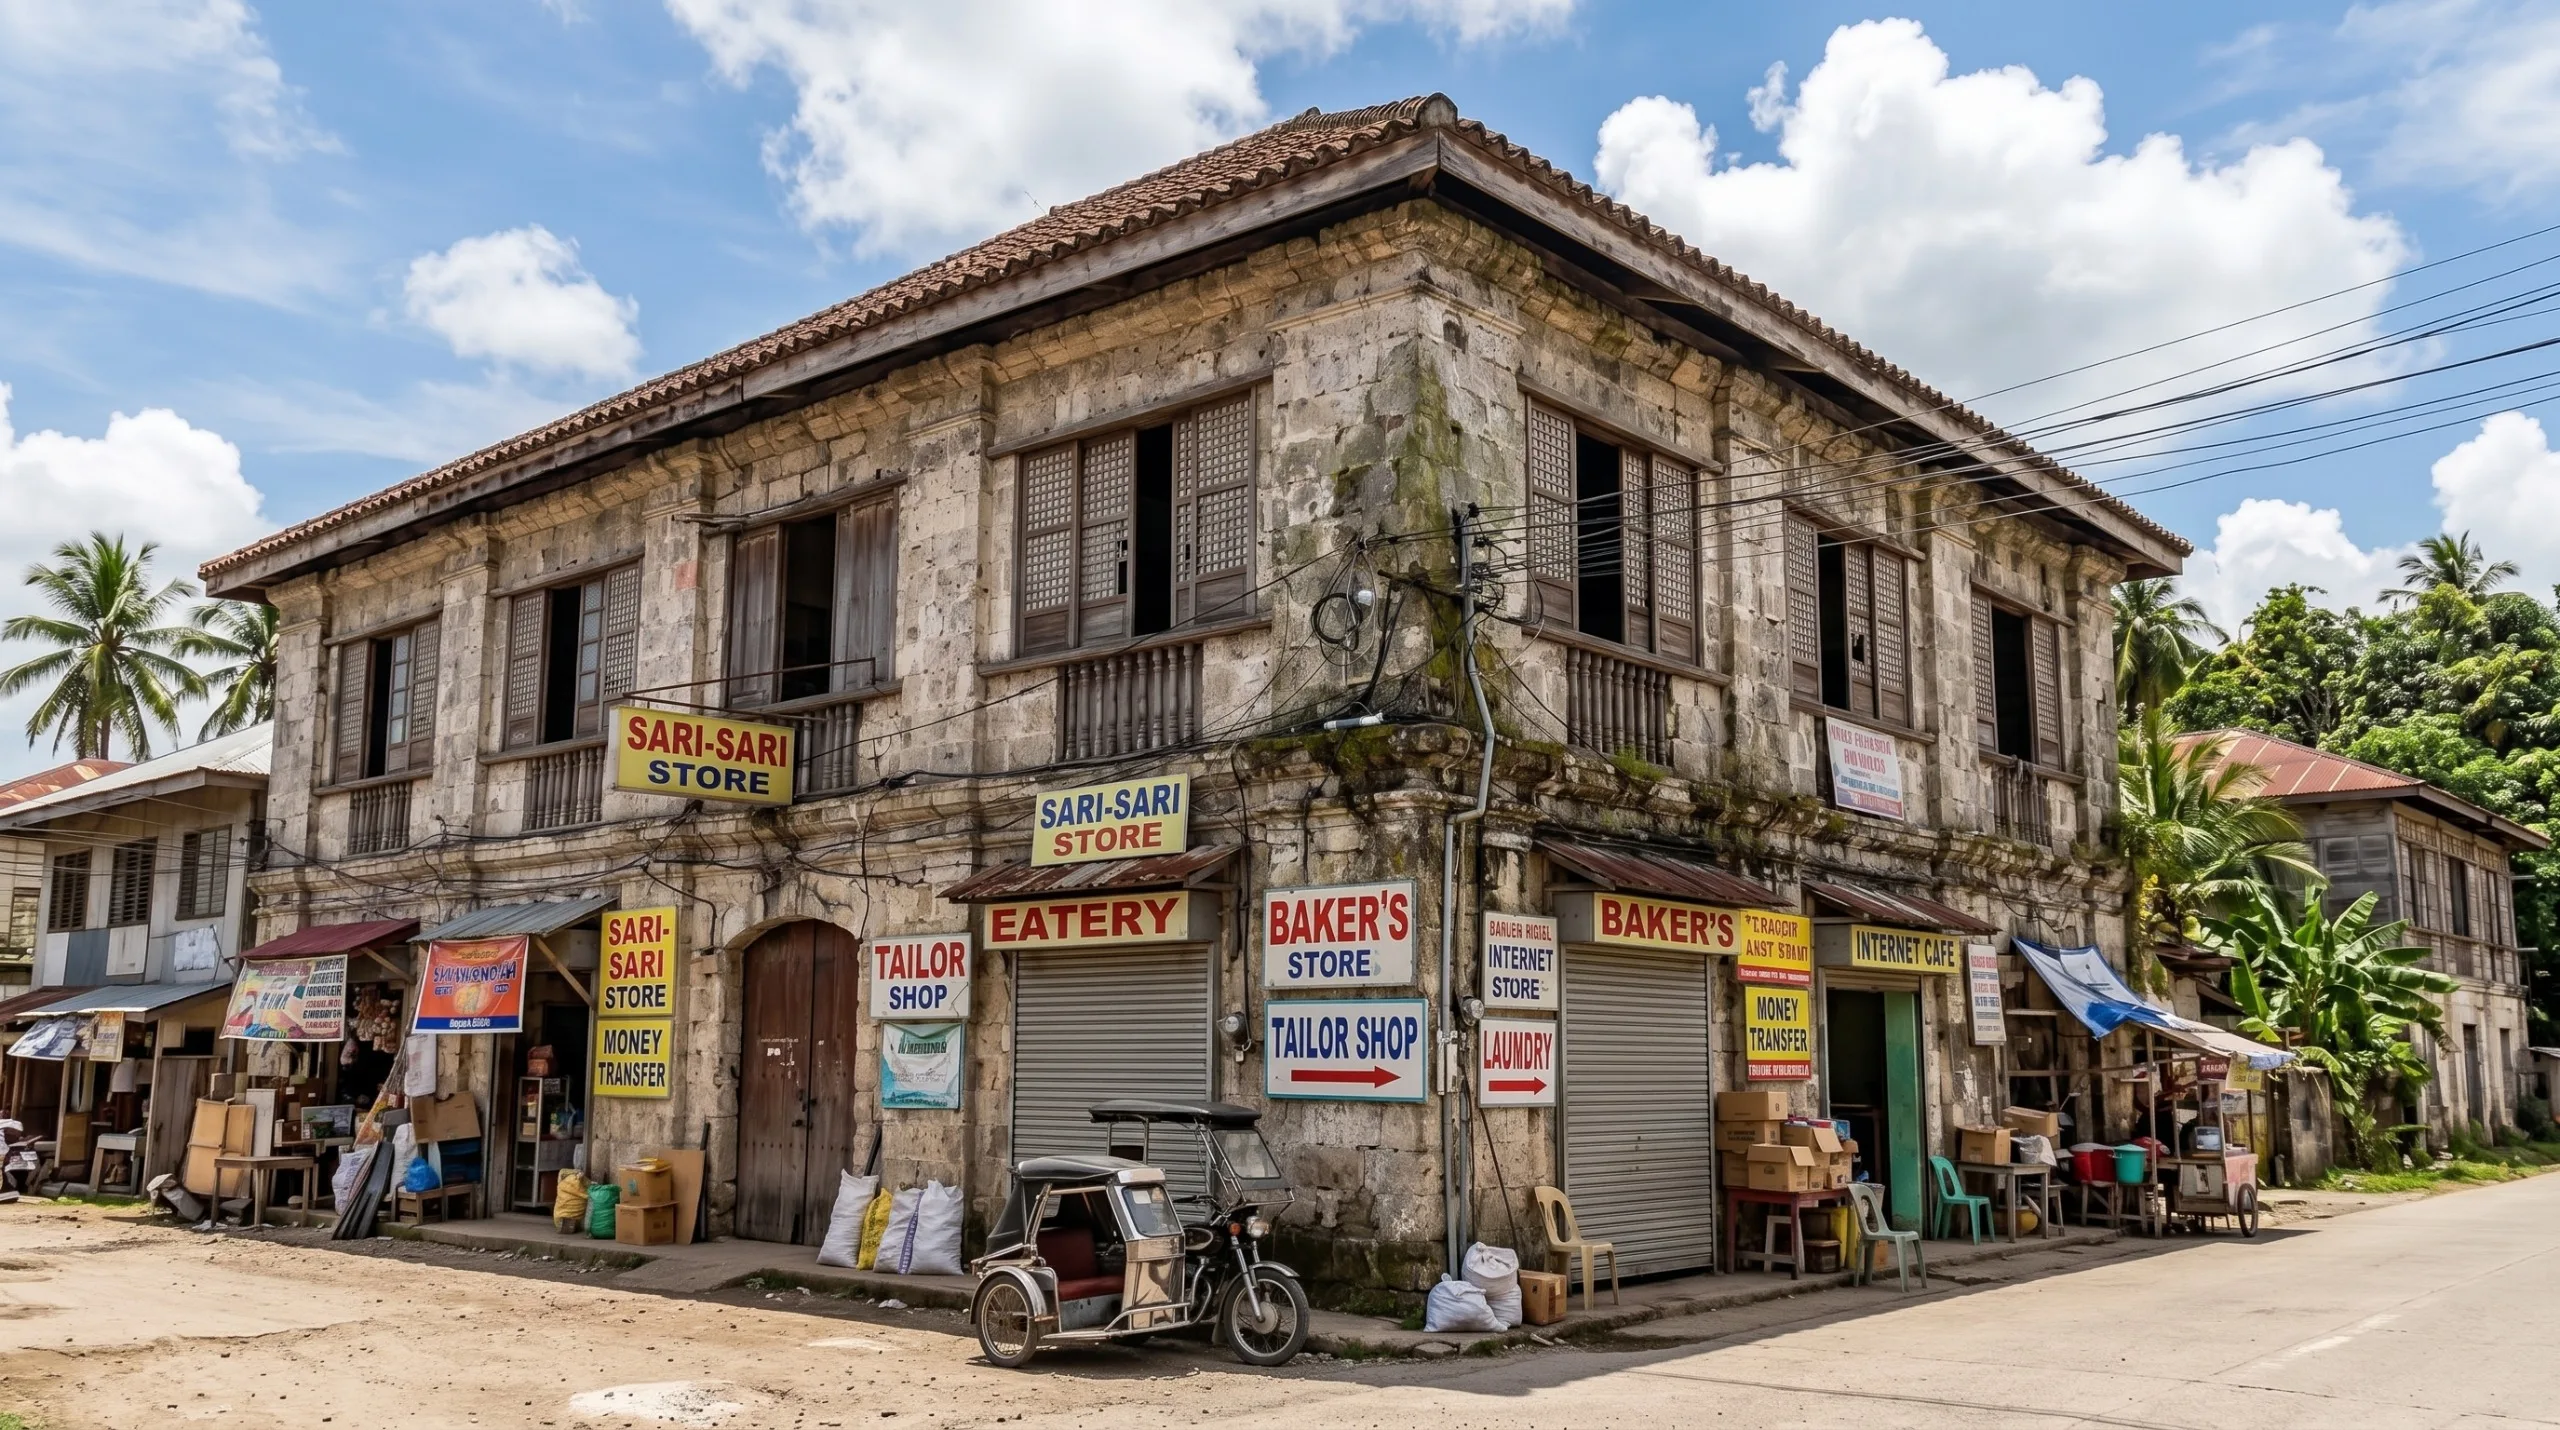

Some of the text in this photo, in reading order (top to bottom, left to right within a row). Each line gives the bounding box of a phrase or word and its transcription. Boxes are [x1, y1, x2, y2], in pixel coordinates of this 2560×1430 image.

[627, 716, 787, 767] SARI-SARI
[648, 760, 769, 795] STORE
[1040, 783, 1180, 829] SARI-SARI
[1053, 822, 1162, 856] STORE
[608, 915, 670, 946] SARI-
[992, 897, 1180, 942] EATERY
[1270, 889, 1409, 945] BAKER'S
[1601, 899, 1734, 948] BAKER'S
[875, 942, 965, 979] TAILOR
[1287, 949, 1371, 979] STORE
[1489, 944, 1554, 972] INTERNET
[1857, 930, 1920, 964] INTERNET
[1924, 938, 1955, 967] CAFE
[609, 950, 663, 980] SARI
[605, 984, 666, 1009] STORE
[889, 984, 948, 1010] SHOP
[1492, 976, 1540, 1000] STORE
[1757, 996, 1799, 1021] MONEY
[603, 1029, 663, 1055] MONEY
[1272, 1016, 1418, 1060] TAILOR SHOP
[1750, 1027, 1808, 1052] TRANSFER
[598, 1062, 665, 1087] TRANSFER
